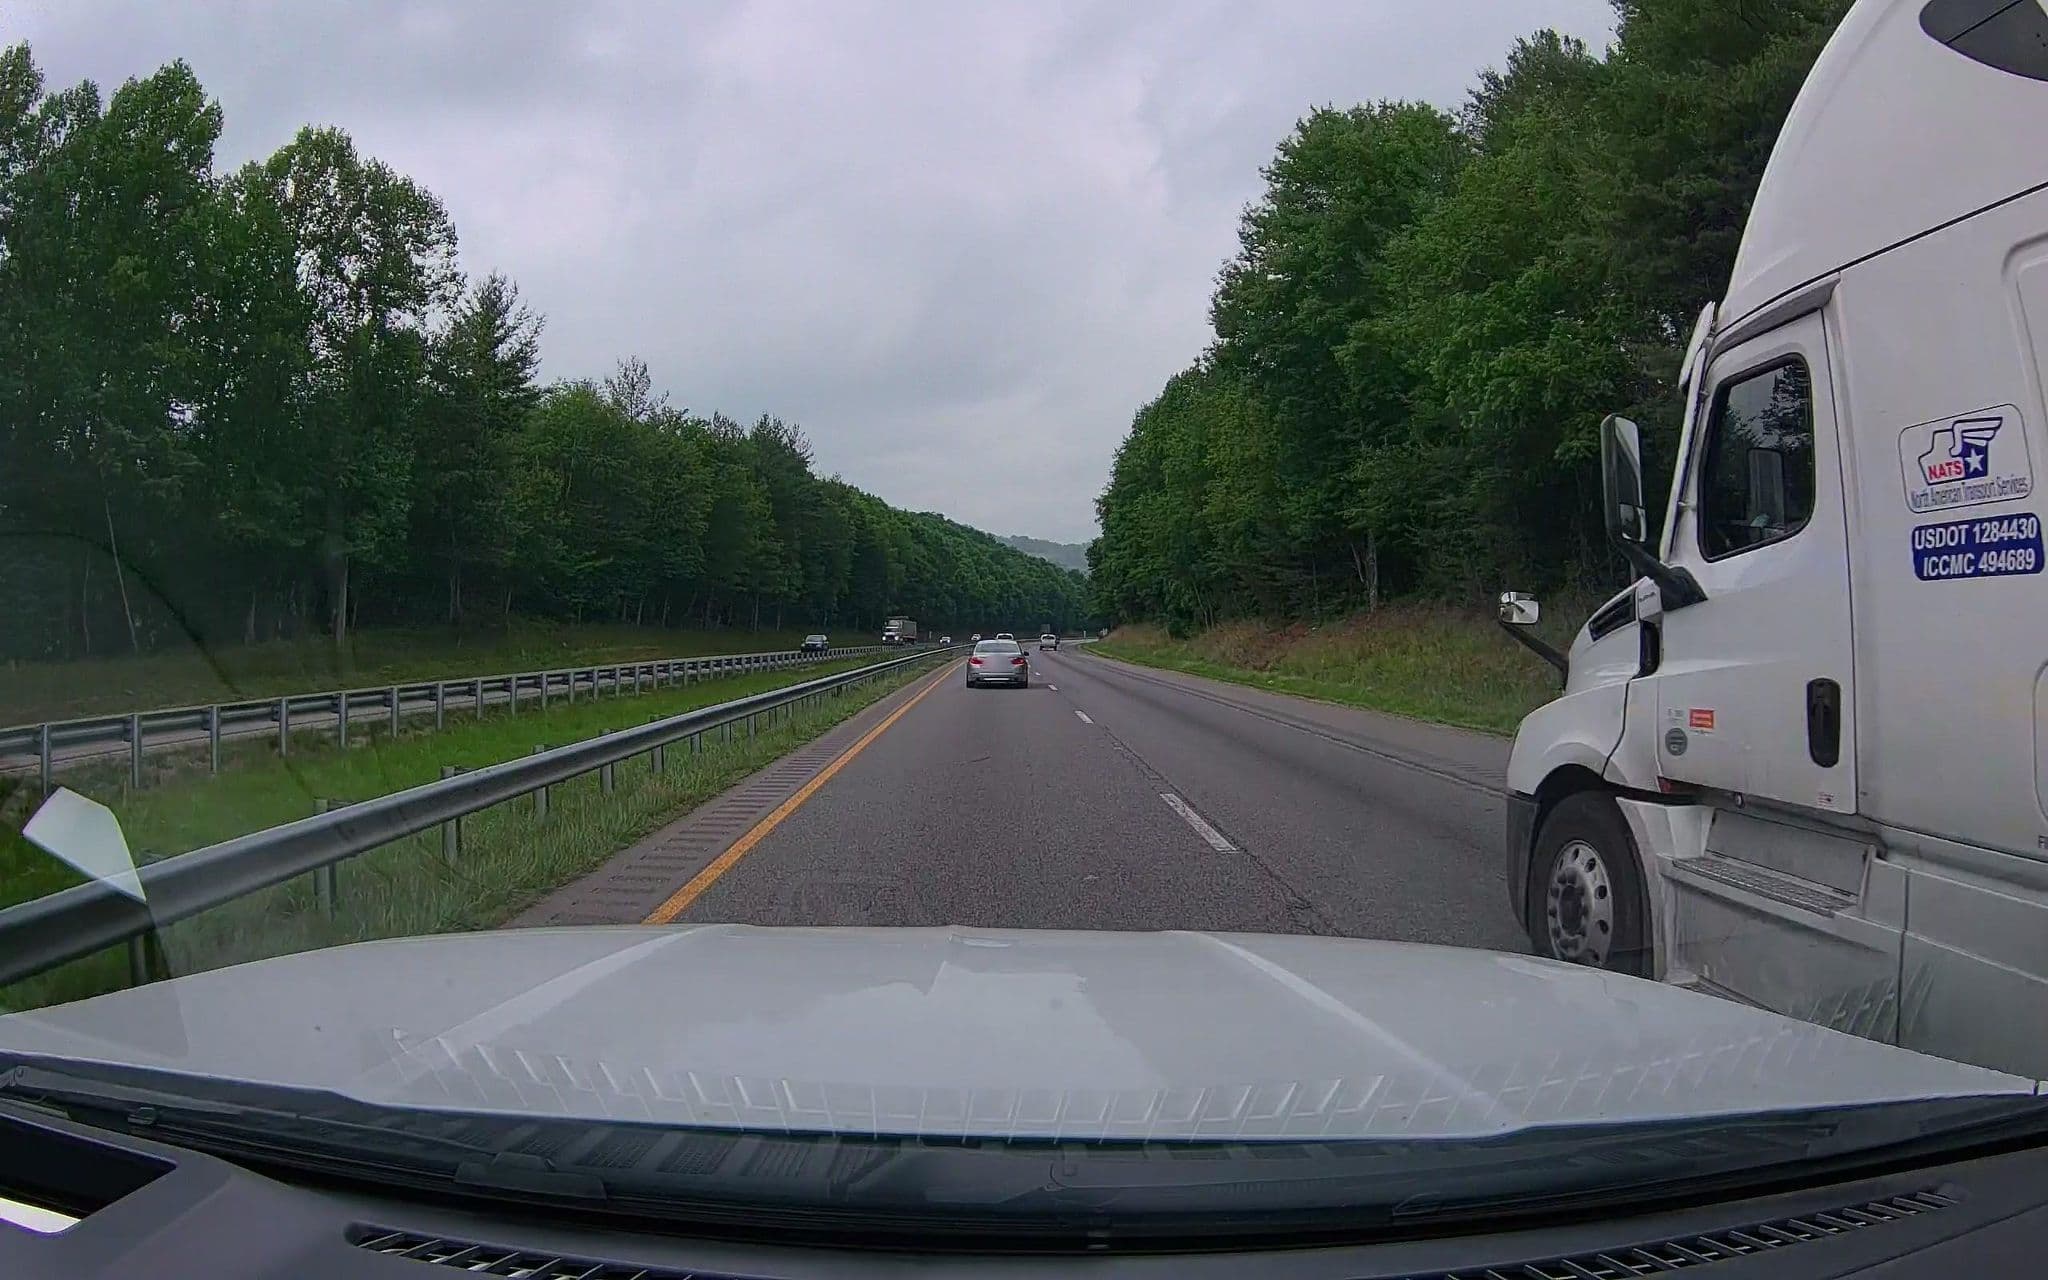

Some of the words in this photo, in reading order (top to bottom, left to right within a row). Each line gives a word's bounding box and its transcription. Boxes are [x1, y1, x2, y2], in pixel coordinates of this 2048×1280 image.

[1928, 461, 1963, 480] NATS
[1915, 525, 1969, 549] USDOT
[1973, 518, 2036, 544] 1284430
[1924, 554, 1975, 576] ICCMC
[1979, 548, 2035, 571] 494689
